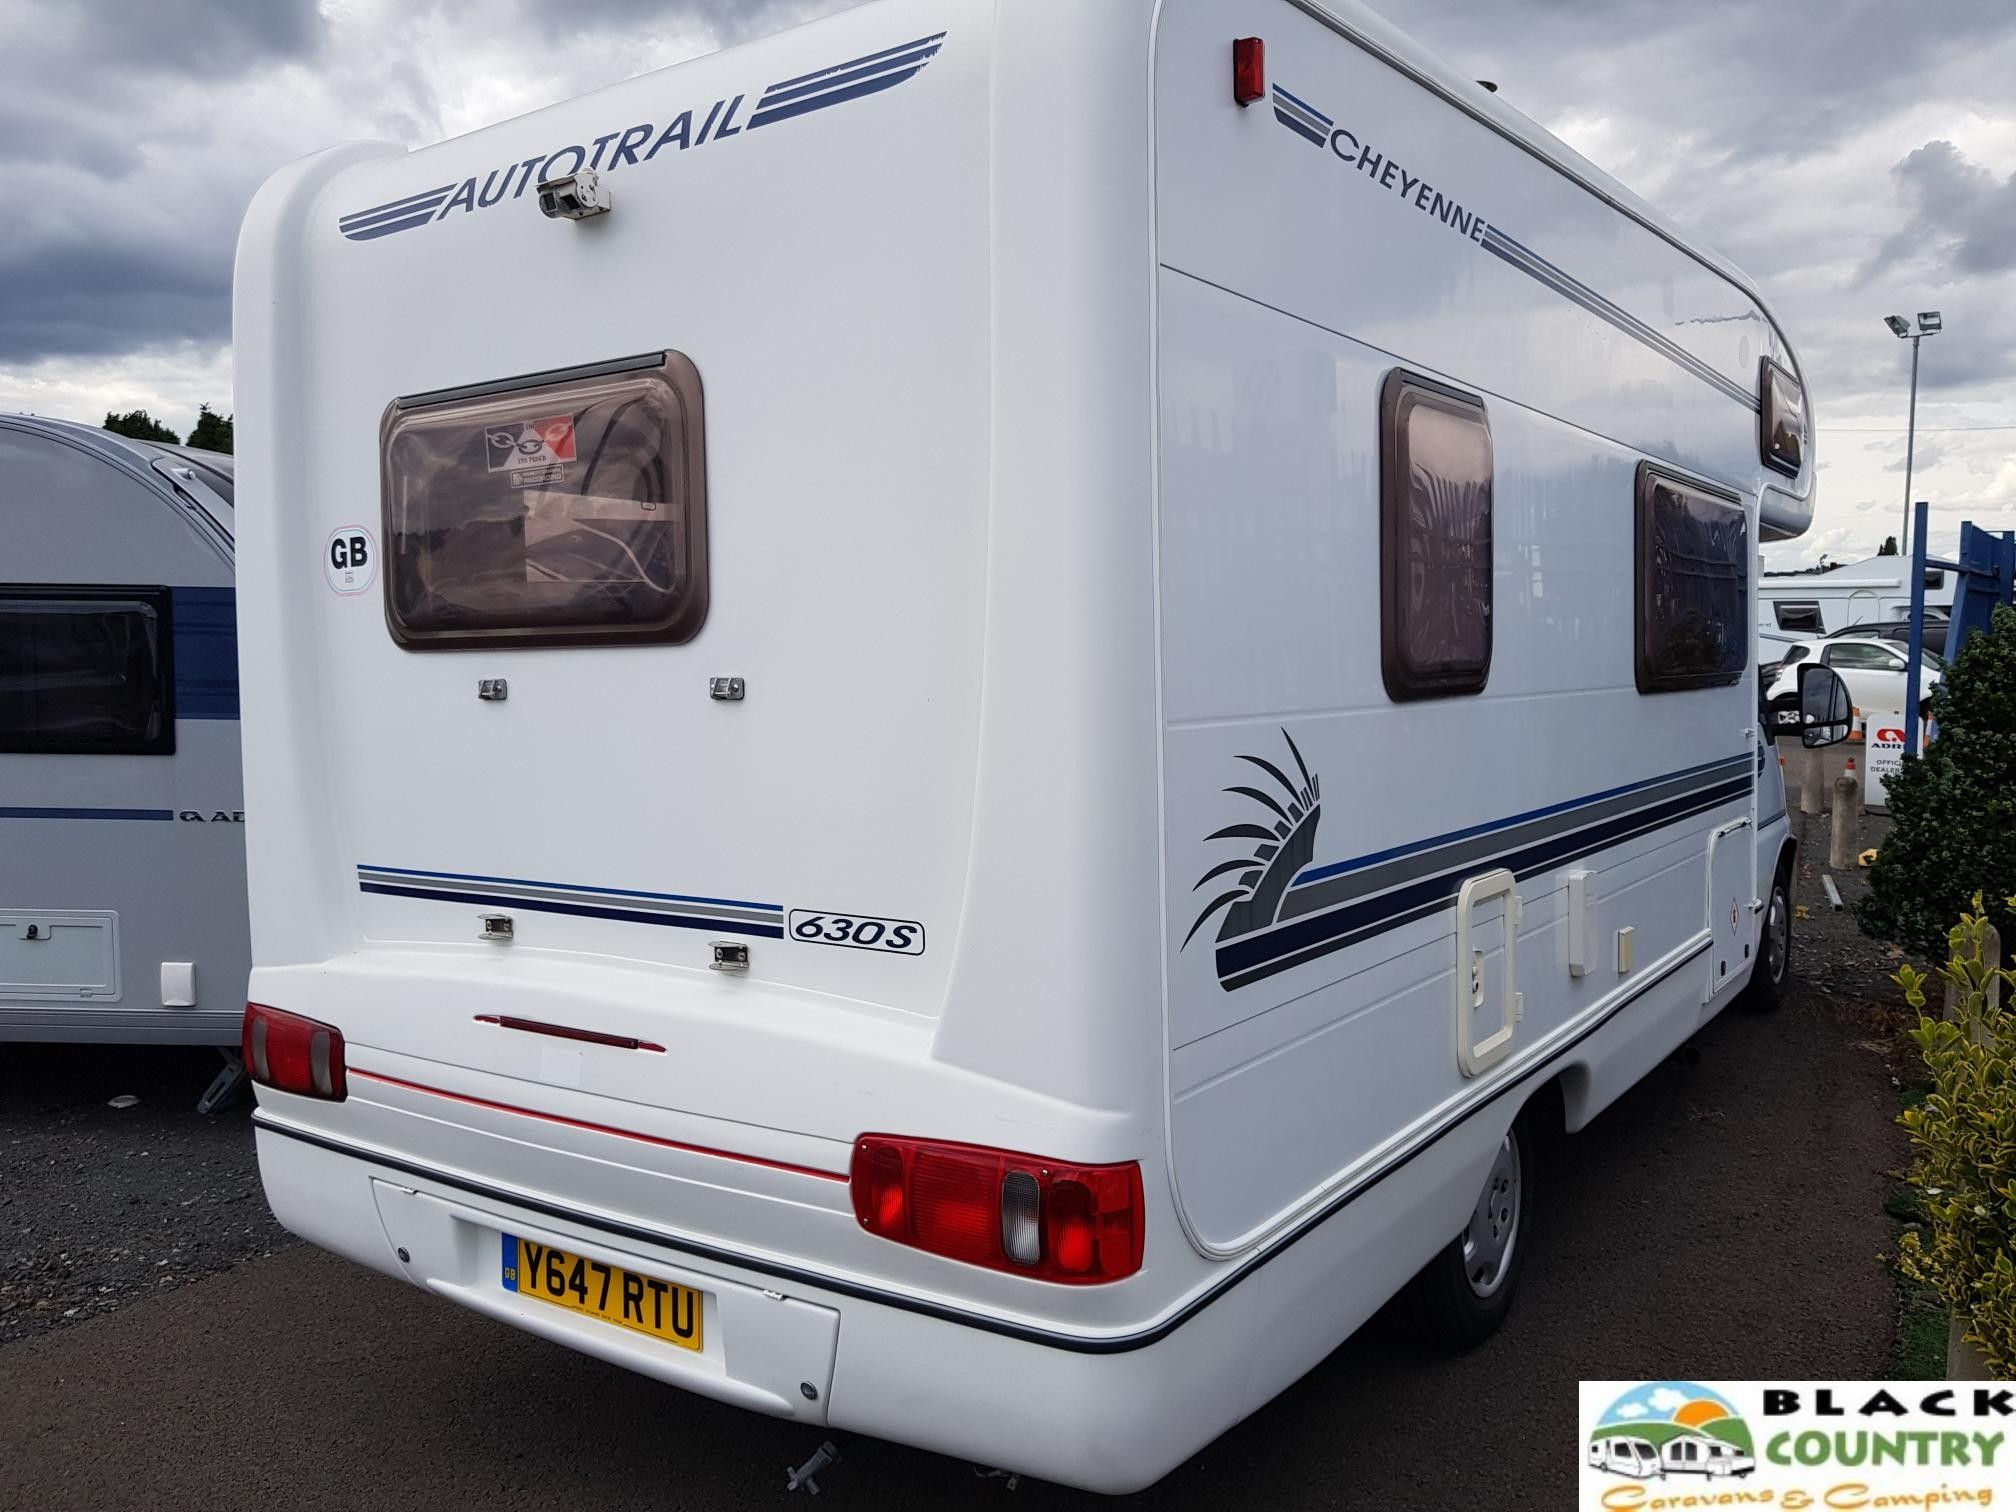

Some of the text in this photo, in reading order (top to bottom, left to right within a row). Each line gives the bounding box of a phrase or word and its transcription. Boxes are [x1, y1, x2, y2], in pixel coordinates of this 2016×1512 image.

[436, 94, 745, 221] AUTOTRAIL
[1330, 129, 1486, 242] CHEYENNE
[331, 536, 368, 570] GB
[795, 916, 918, 949] 630S
[524, 1242, 694, 1339] Y647 RTU
